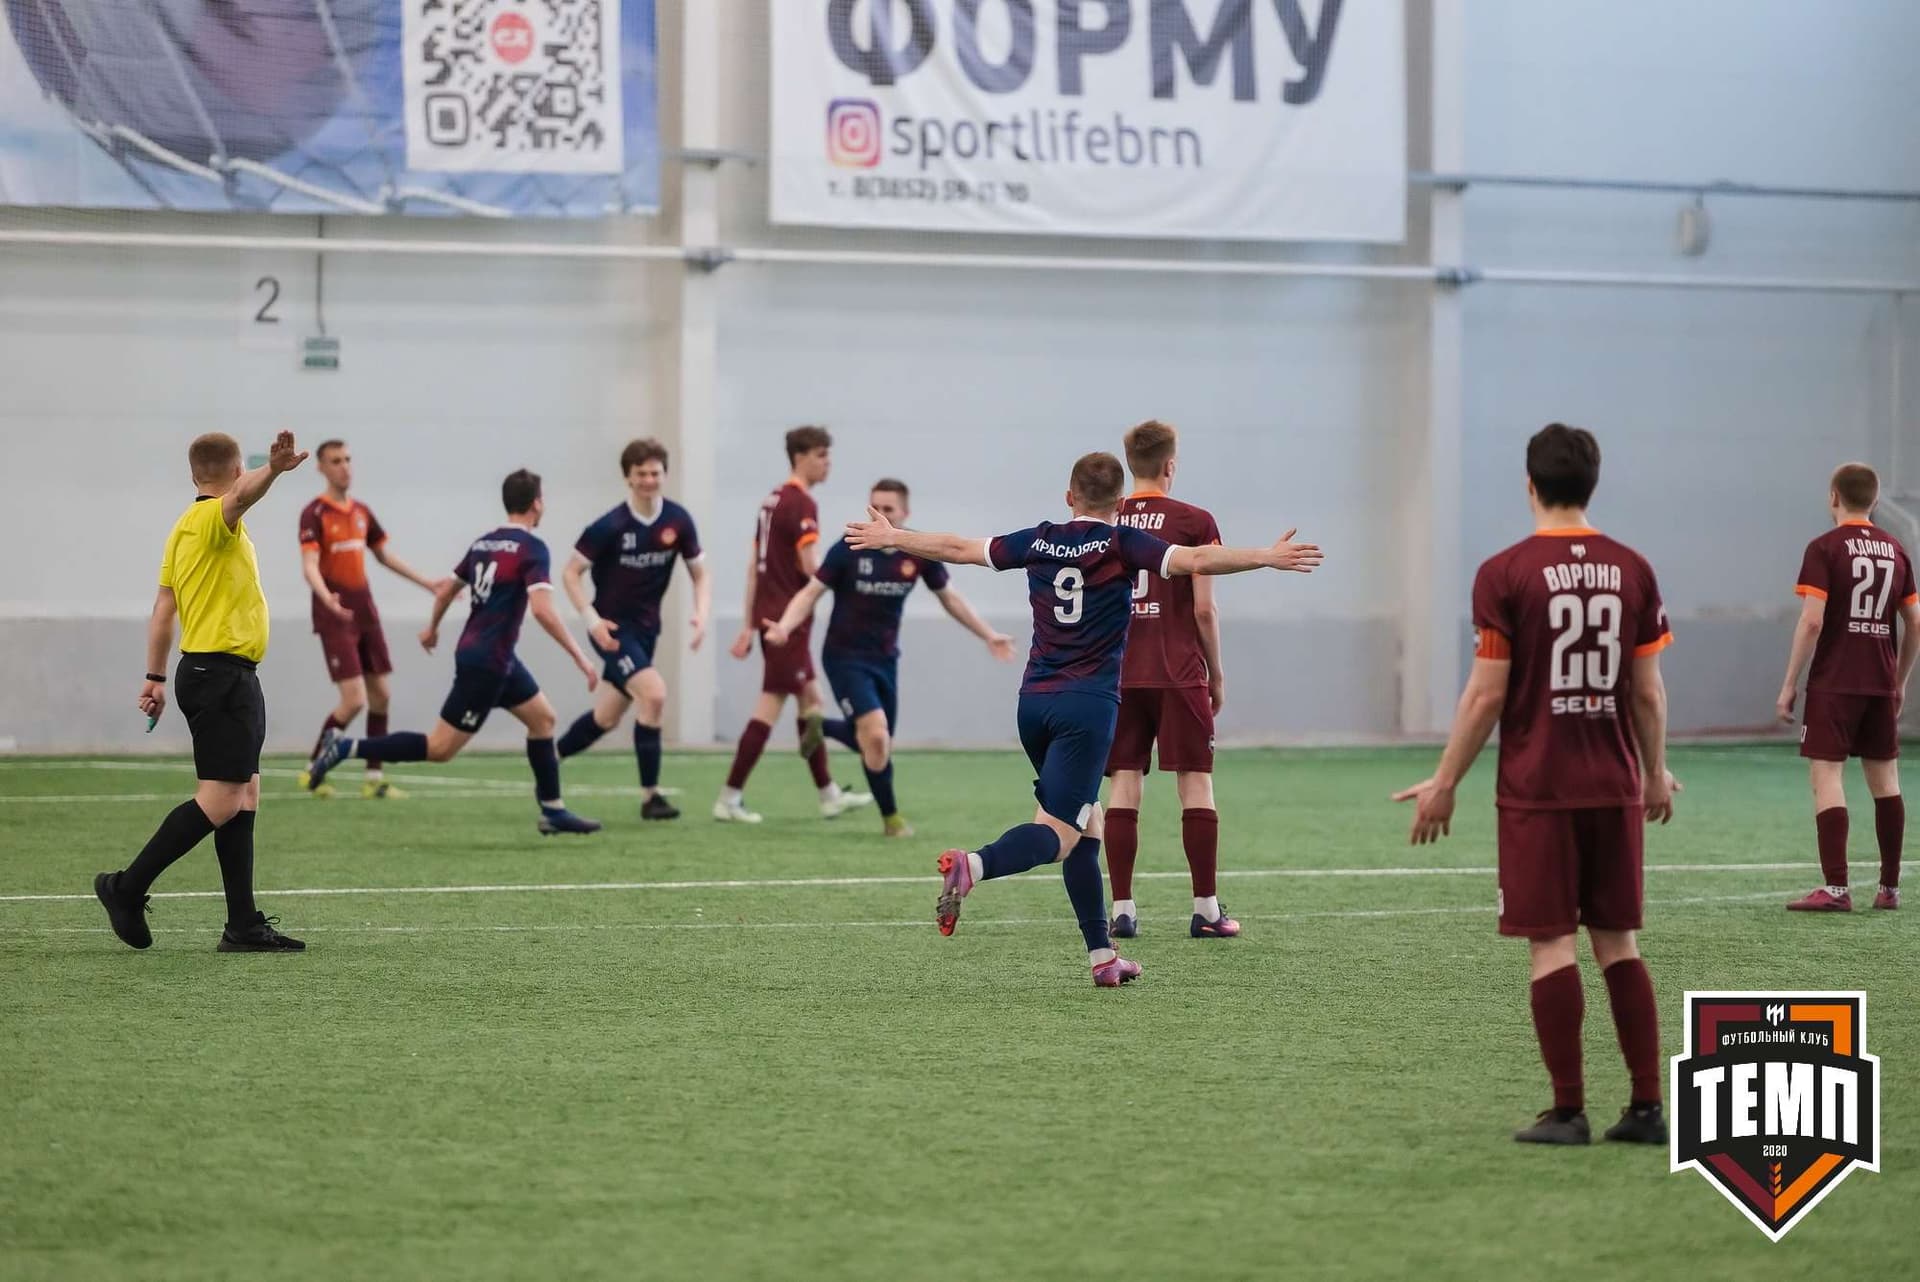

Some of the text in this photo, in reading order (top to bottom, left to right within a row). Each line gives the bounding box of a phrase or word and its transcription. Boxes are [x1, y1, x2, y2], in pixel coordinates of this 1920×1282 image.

[827, 0, 1344, 104] ФОРМУ
[890, 108, 1203, 170] sportlifebrn
[255, 277, 280, 322] 2
[1845, 538, 1895, 559] ЖДАНОВ
[1053, 567, 1085, 624] 9
[1543, 563, 1622, 592] ВОРОНА
[1850, 556, 1895, 619] 27
[1131, 603, 1160, 614] US
[1848, 621, 1890, 635] SEUS
[1549, 594, 1623, 690] 23
[1551, 696, 1617, 714] SEUS
